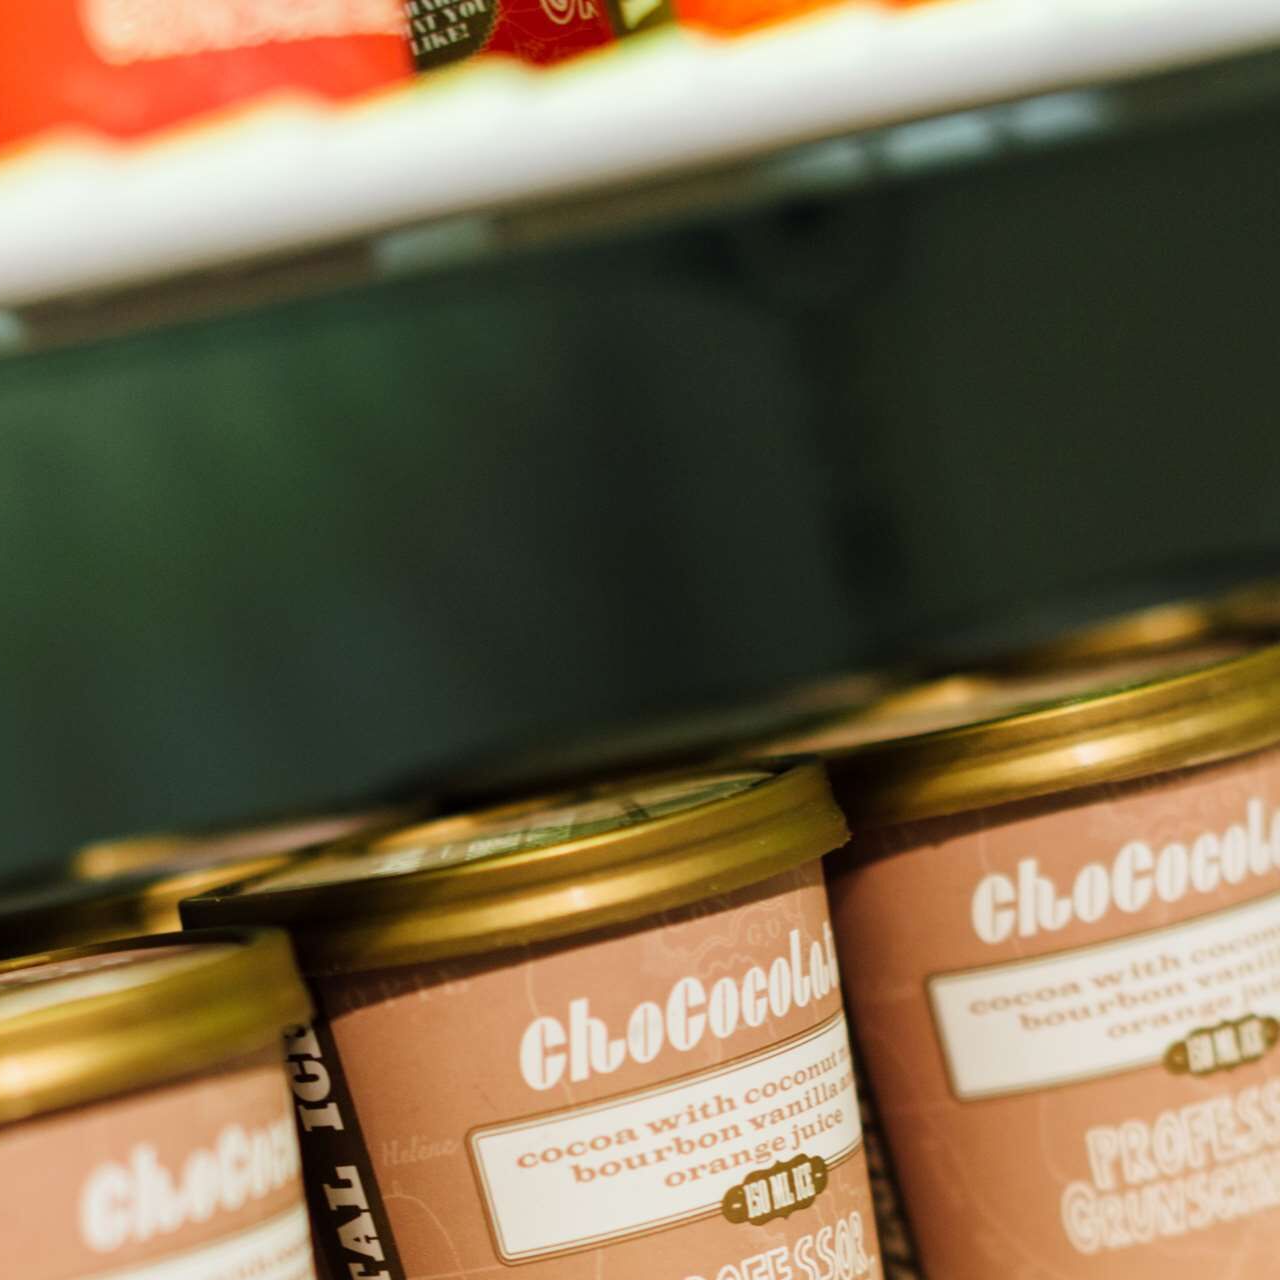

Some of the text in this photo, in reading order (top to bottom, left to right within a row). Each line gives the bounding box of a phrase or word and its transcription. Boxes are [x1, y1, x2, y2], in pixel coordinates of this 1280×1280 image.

[515, 1051, 838, 1170] cocoa with coconut
[570, 1120, 743, 1184] bourbon
[748, 1081, 839, 1132] vanilla
[663, 1107, 844, 1188] orange juice
